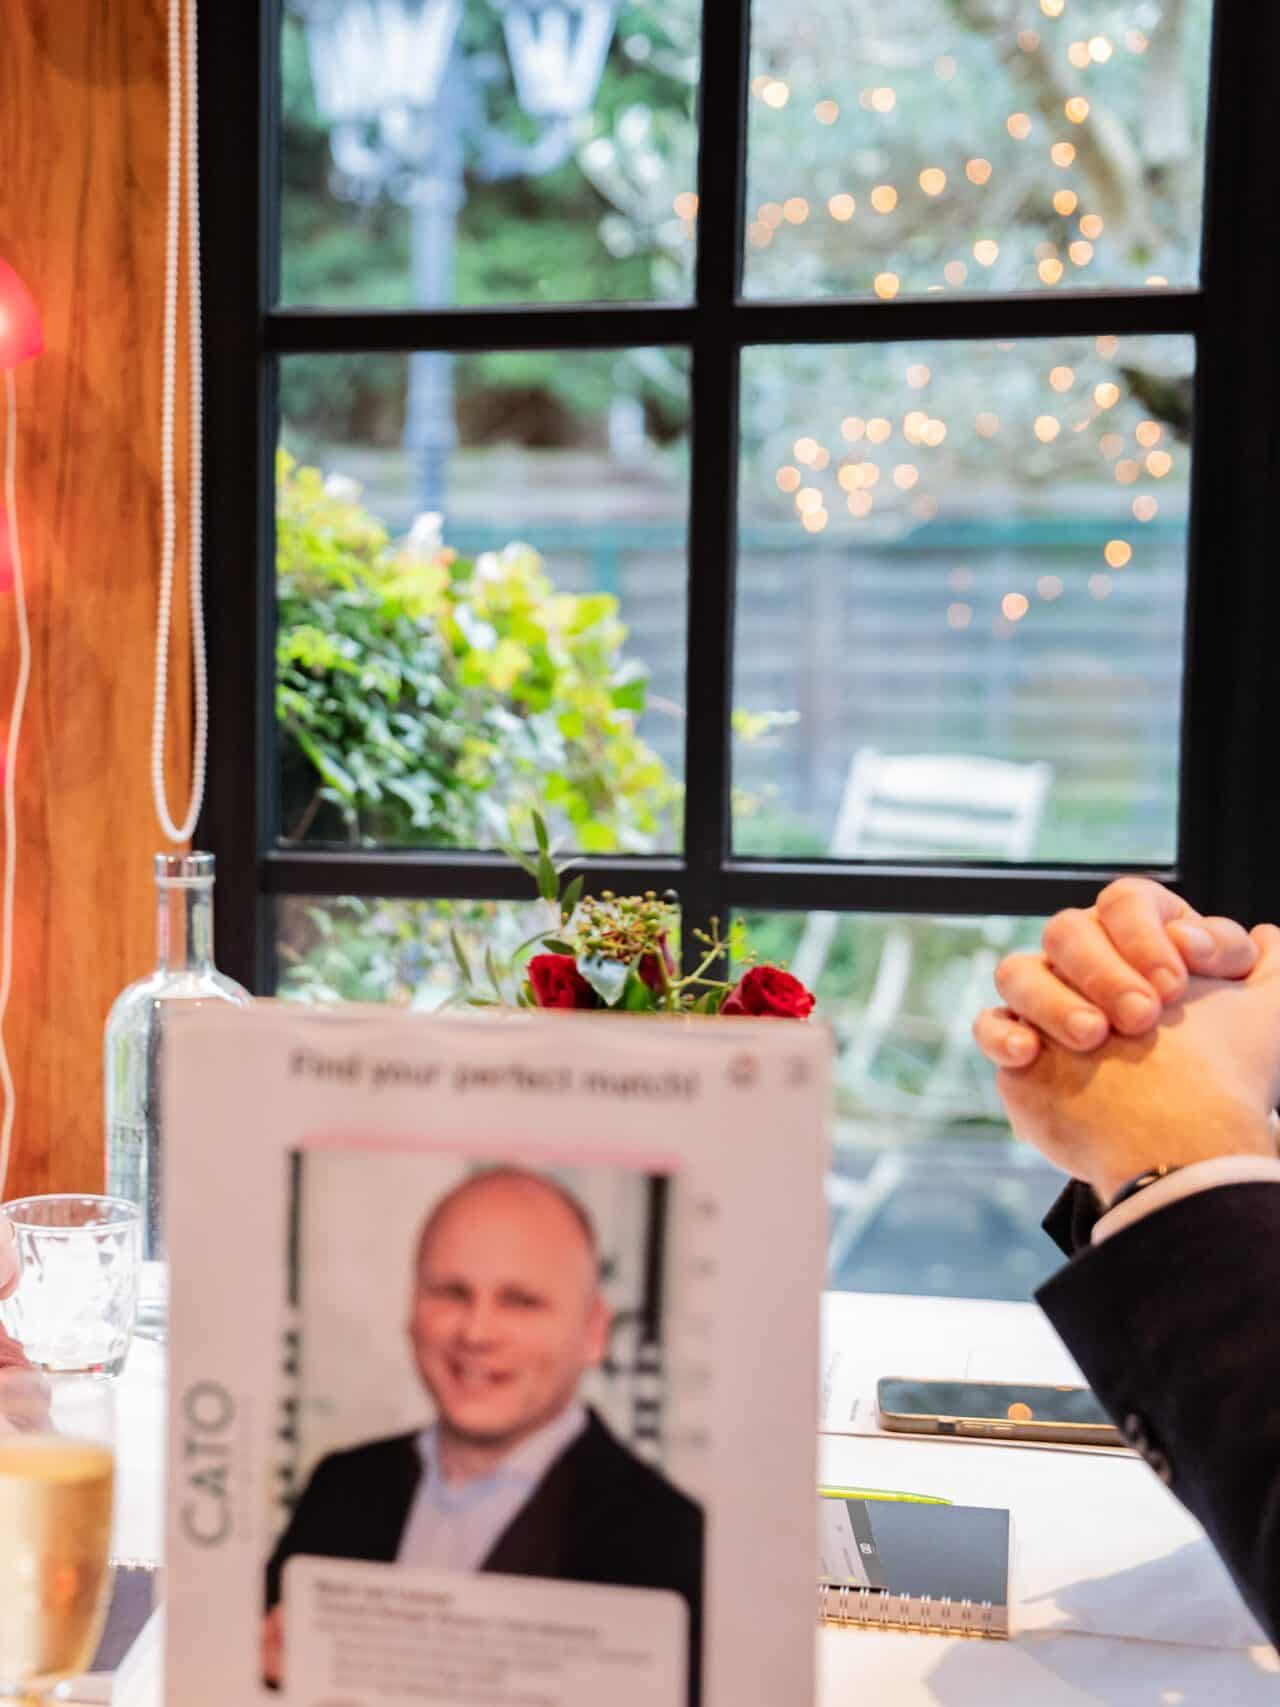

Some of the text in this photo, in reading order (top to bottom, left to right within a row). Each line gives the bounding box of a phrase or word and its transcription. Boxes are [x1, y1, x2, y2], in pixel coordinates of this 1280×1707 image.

[289, 1047, 360, 1083] Find
[370, 1060, 438, 1094] your
[452, 1060, 573, 1096] perfect
[179, 1379, 235, 1550] CATO
